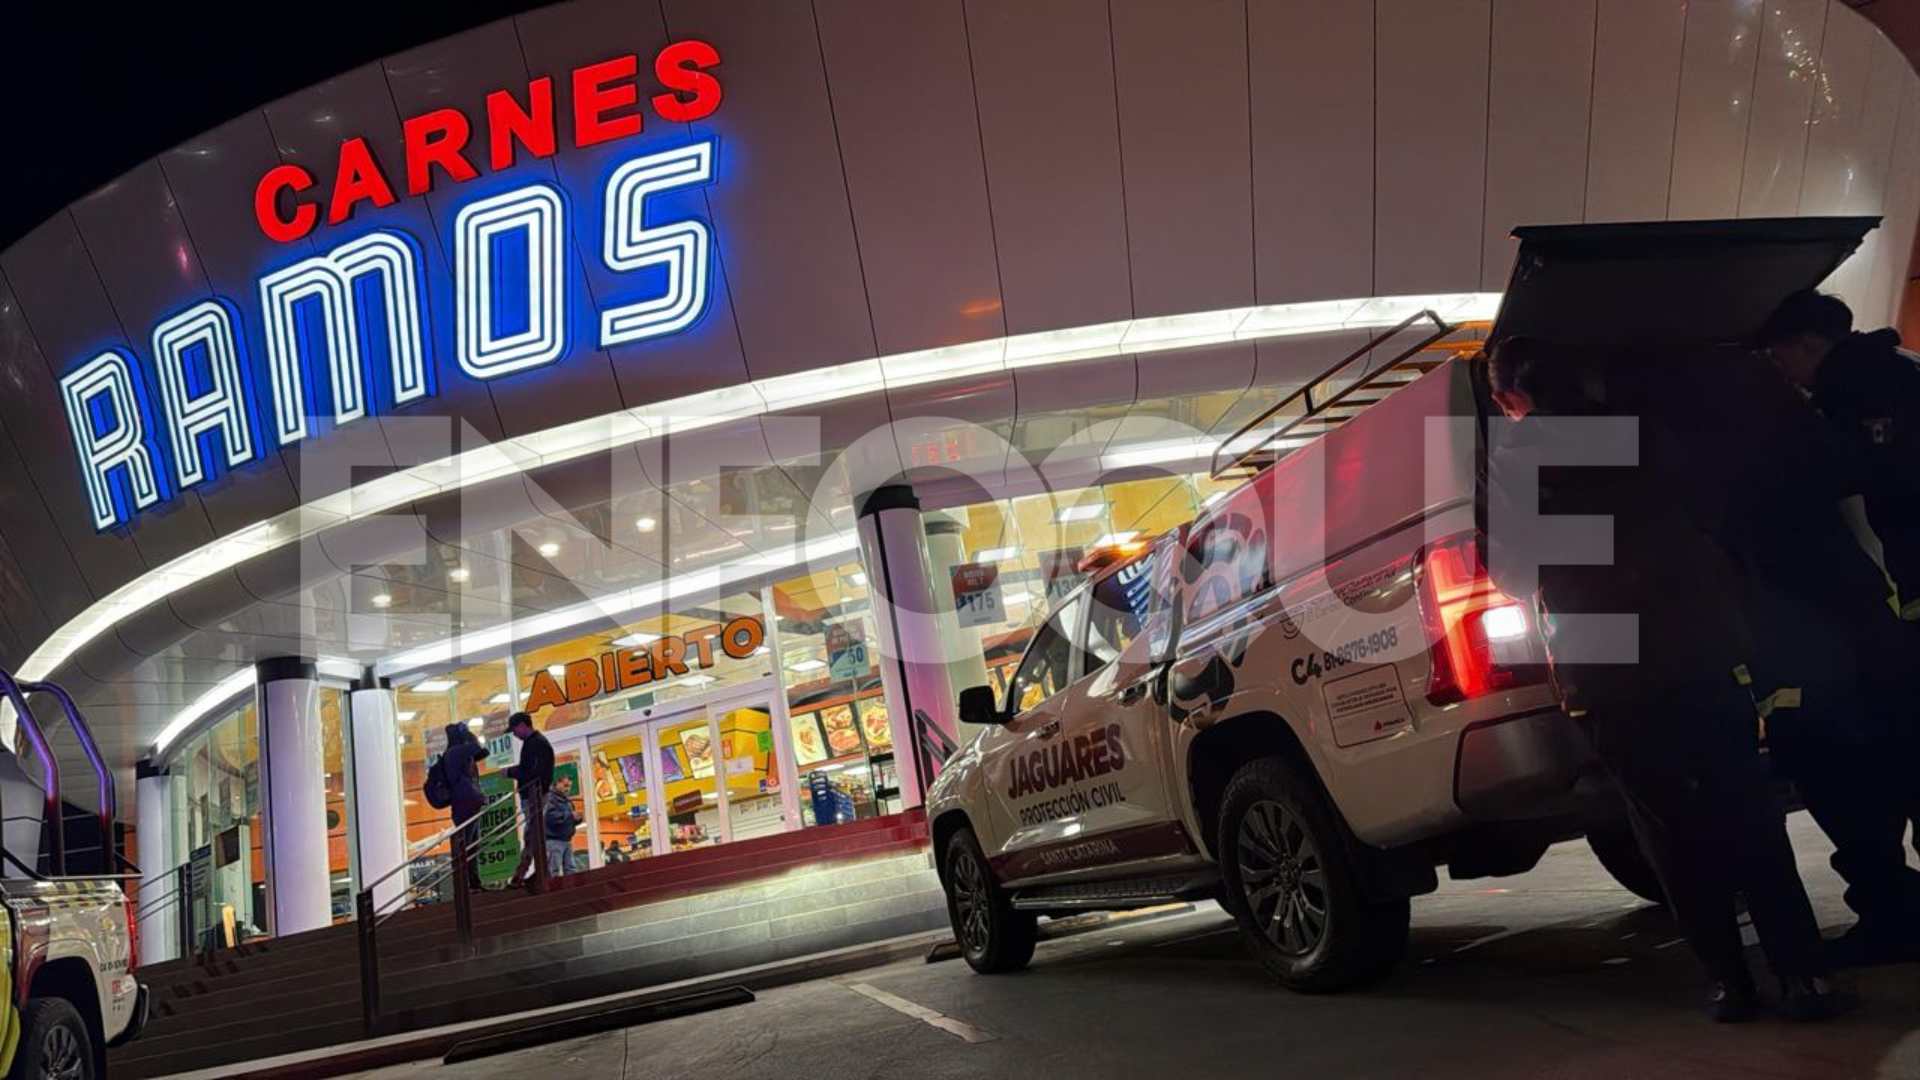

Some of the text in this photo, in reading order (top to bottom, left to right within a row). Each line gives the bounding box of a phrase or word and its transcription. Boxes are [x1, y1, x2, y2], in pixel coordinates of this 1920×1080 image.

[254, 40, 722, 243] CARNES
[60, 141, 715, 531] RAMOS
[526, 616, 764, 713] ABIERTO
[1291, 653, 1322, 685] C4
[1008, 723, 1126, 799] JAGUARES
[1020, 781, 1126, 826] PROTECCIÓN CIVIL
